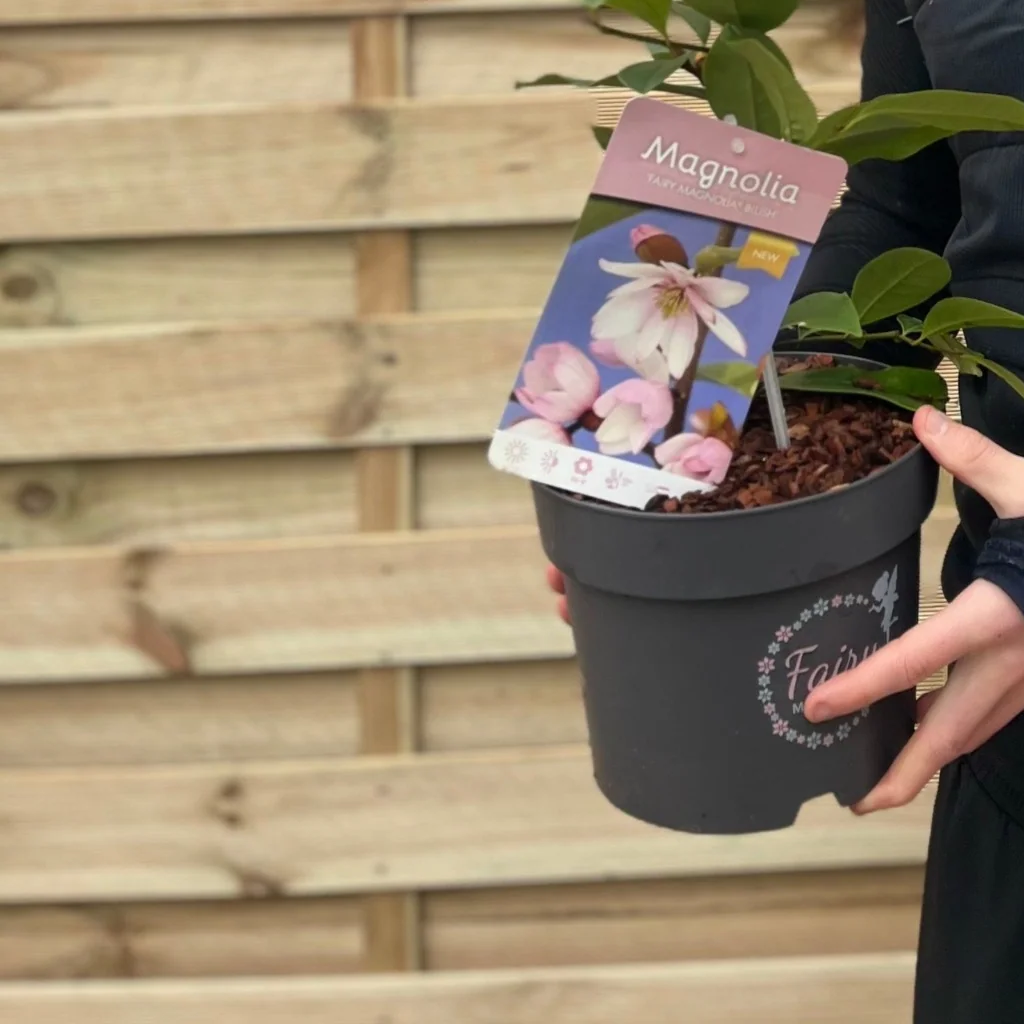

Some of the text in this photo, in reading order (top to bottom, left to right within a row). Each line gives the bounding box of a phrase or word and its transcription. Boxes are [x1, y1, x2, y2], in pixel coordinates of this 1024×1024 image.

[640, 135, 800, 205] Magnolia
[648, 173, 677, 190] FAIRY
[752, 248, 780, 263] NEW
